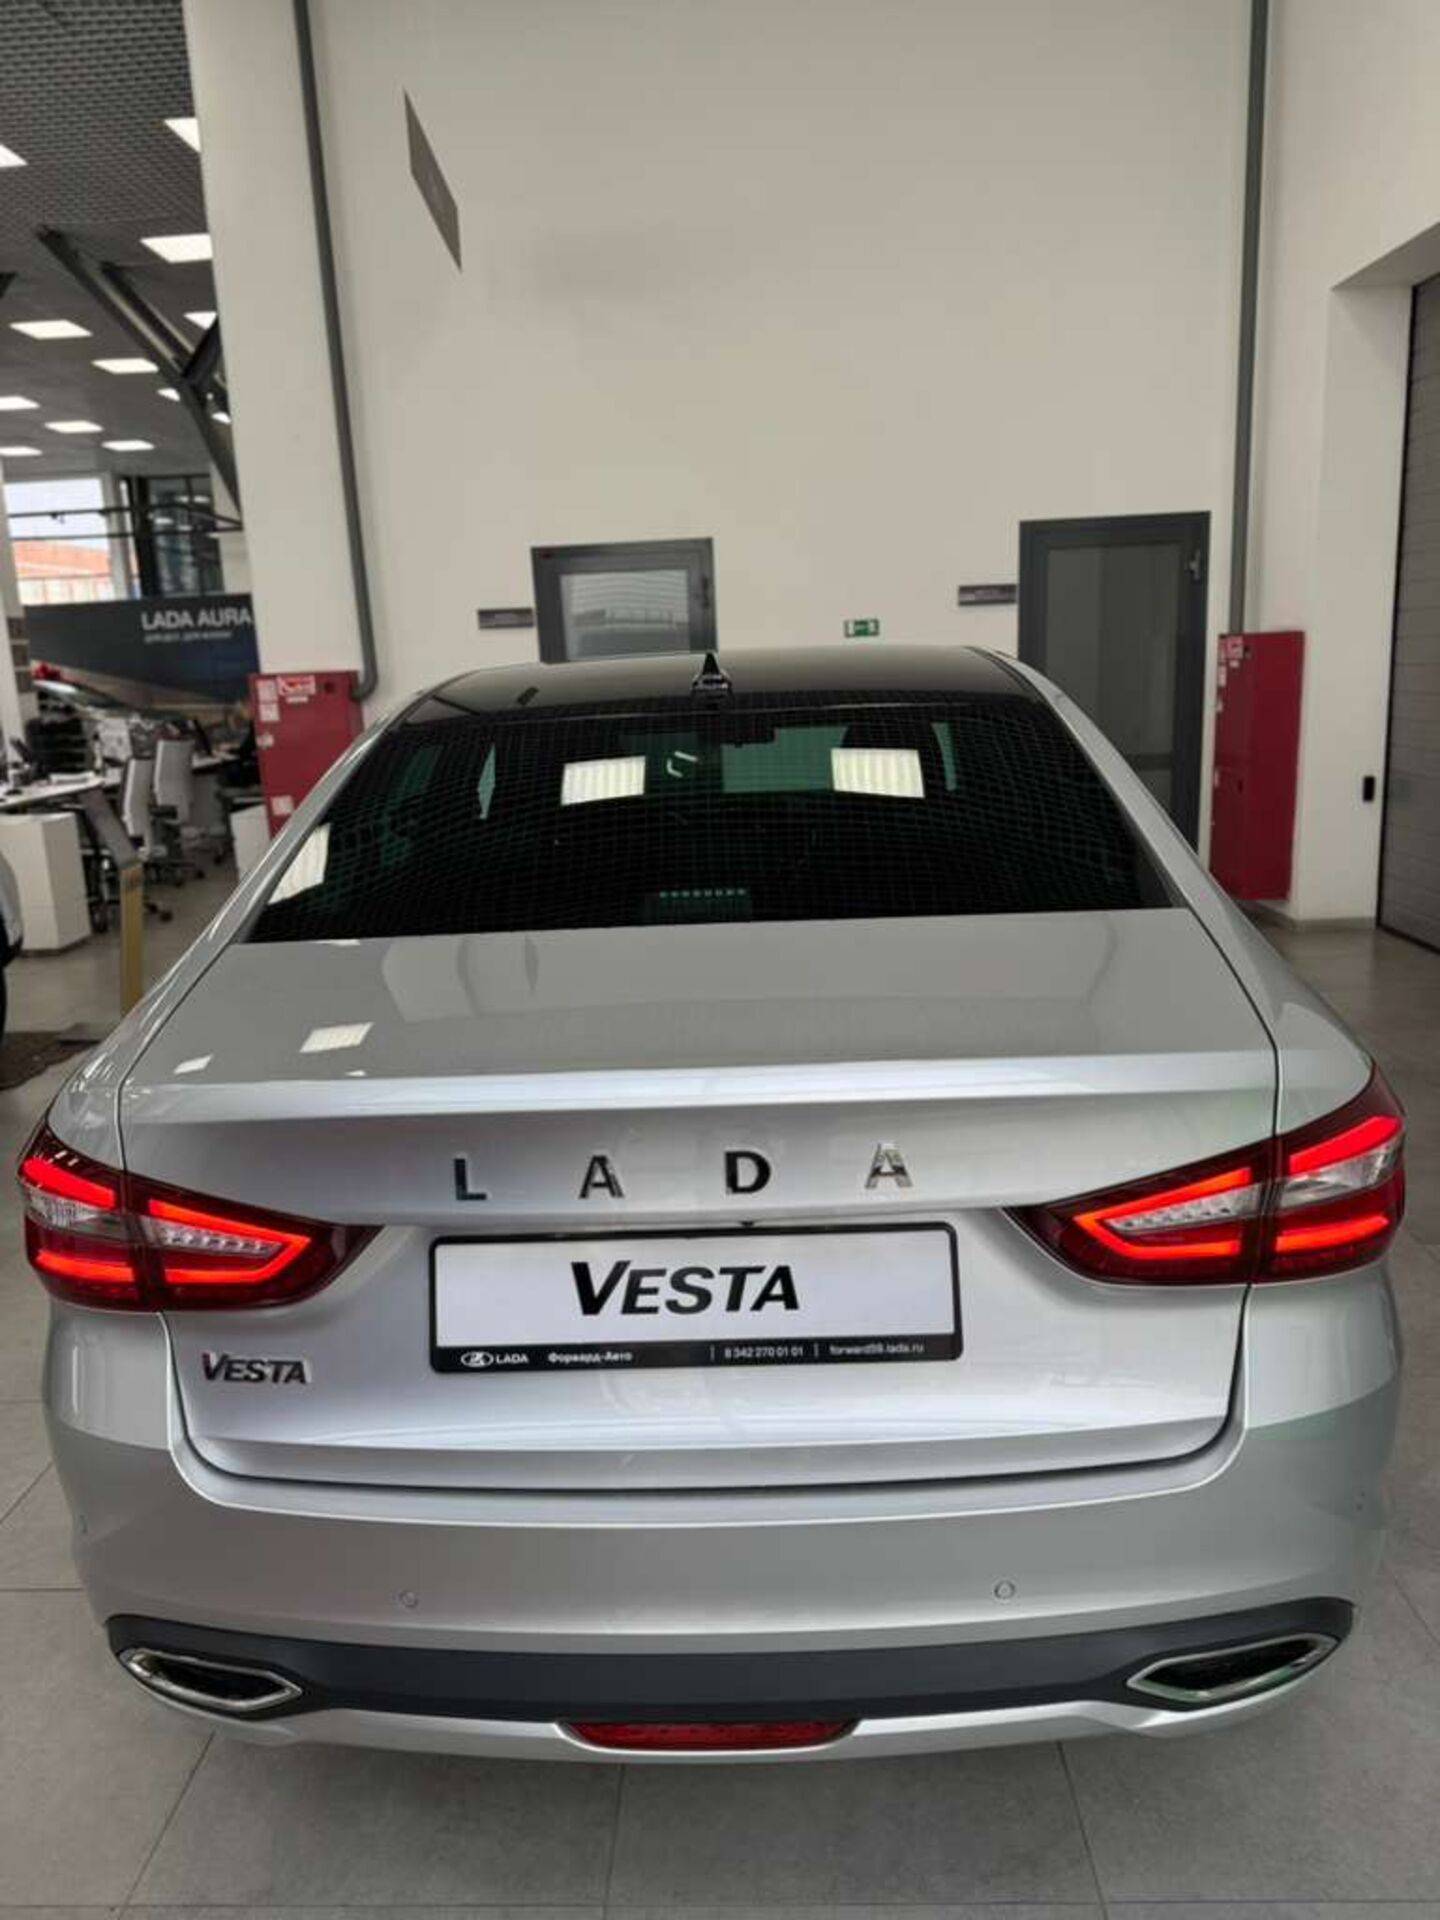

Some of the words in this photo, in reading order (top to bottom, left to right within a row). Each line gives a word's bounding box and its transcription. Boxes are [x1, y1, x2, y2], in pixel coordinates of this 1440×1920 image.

[141, 610, 195, 630] LADA
[198, 606, 251, 627] AURA
[453, 1142, 914, 1201] LADA
[571, 1259, 801, 1317] VESTA
[201, 1351, 312, 1384] VESTA
[496, 1353, 529, 1364] LADA
